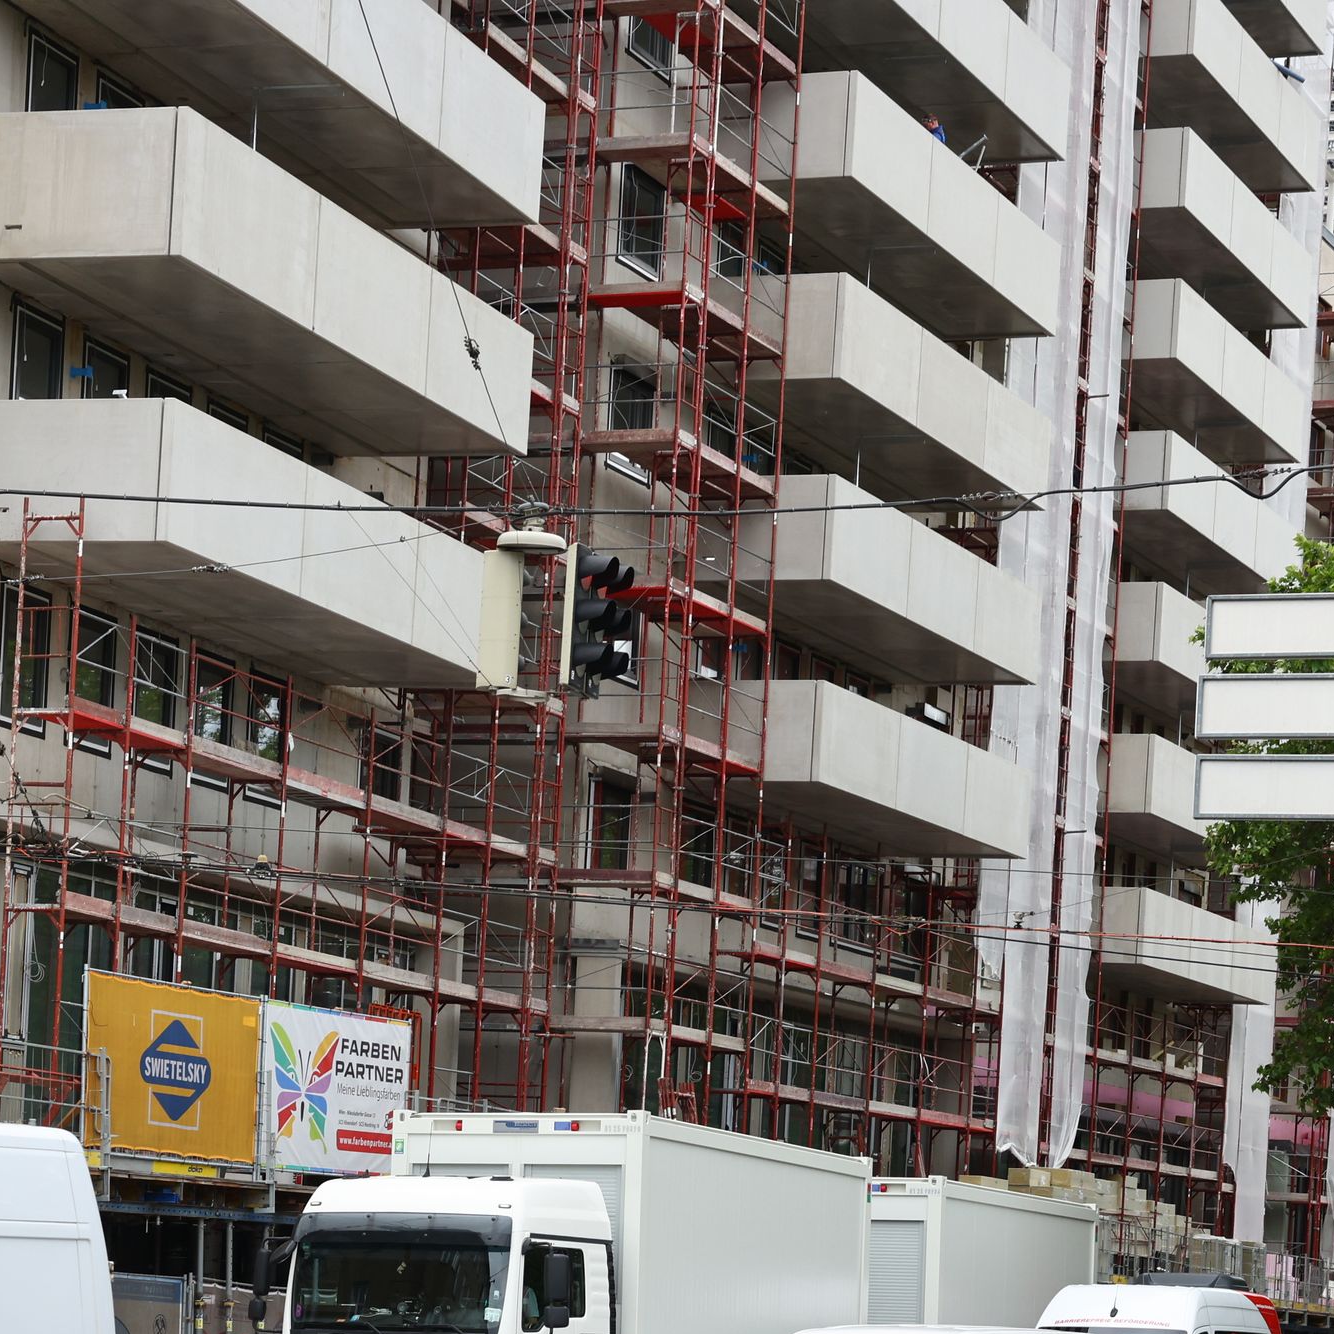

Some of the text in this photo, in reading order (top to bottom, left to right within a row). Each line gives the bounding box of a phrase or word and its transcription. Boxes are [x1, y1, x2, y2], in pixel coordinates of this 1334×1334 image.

[341, 1038, 401, 1061] FARBEN
[145, 1056, 207, 1084] SWIETELSKY
[335, 1060, 404, 1084] PARTNER
[337, 1083, 401, 1102] Meine Lieblingsfarben
